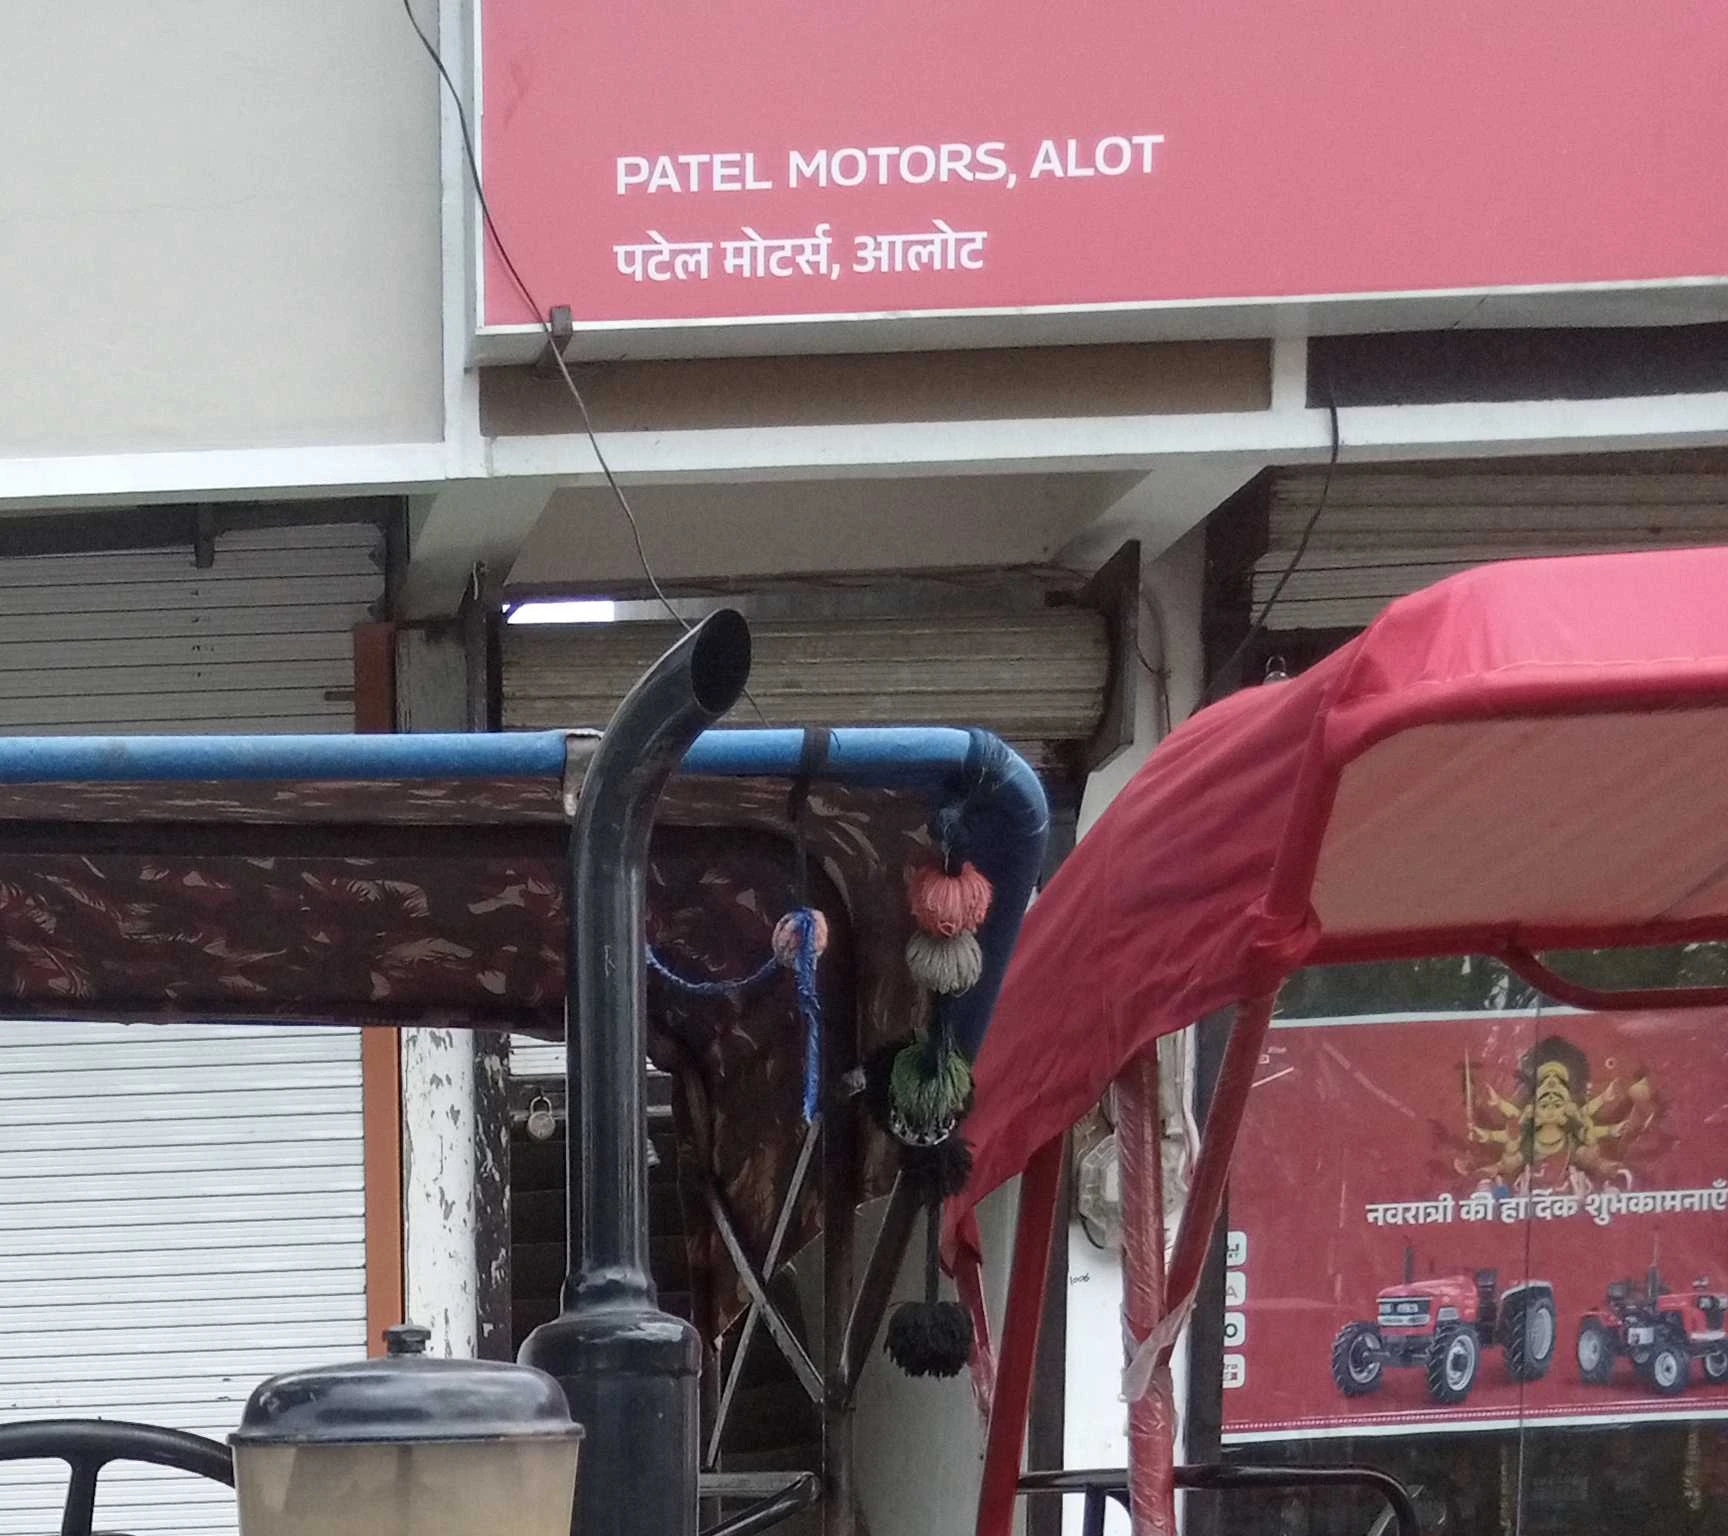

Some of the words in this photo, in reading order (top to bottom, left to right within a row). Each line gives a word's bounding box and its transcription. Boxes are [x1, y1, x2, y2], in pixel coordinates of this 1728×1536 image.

[615, 152, 772, 195] PATEL
[788, 141, 1018, 189] MOTORS,
[1029, 134, 1165, 179] ALOT
[613, 229, 713, 282] पटेल
[720, 222, 841, 280] मोटर्स,
[852, 219, 988, 273] आलोट
[1365, 1193, 1454, 1226] नवरात्री
[1459, 1191, 1493, 1223] की
